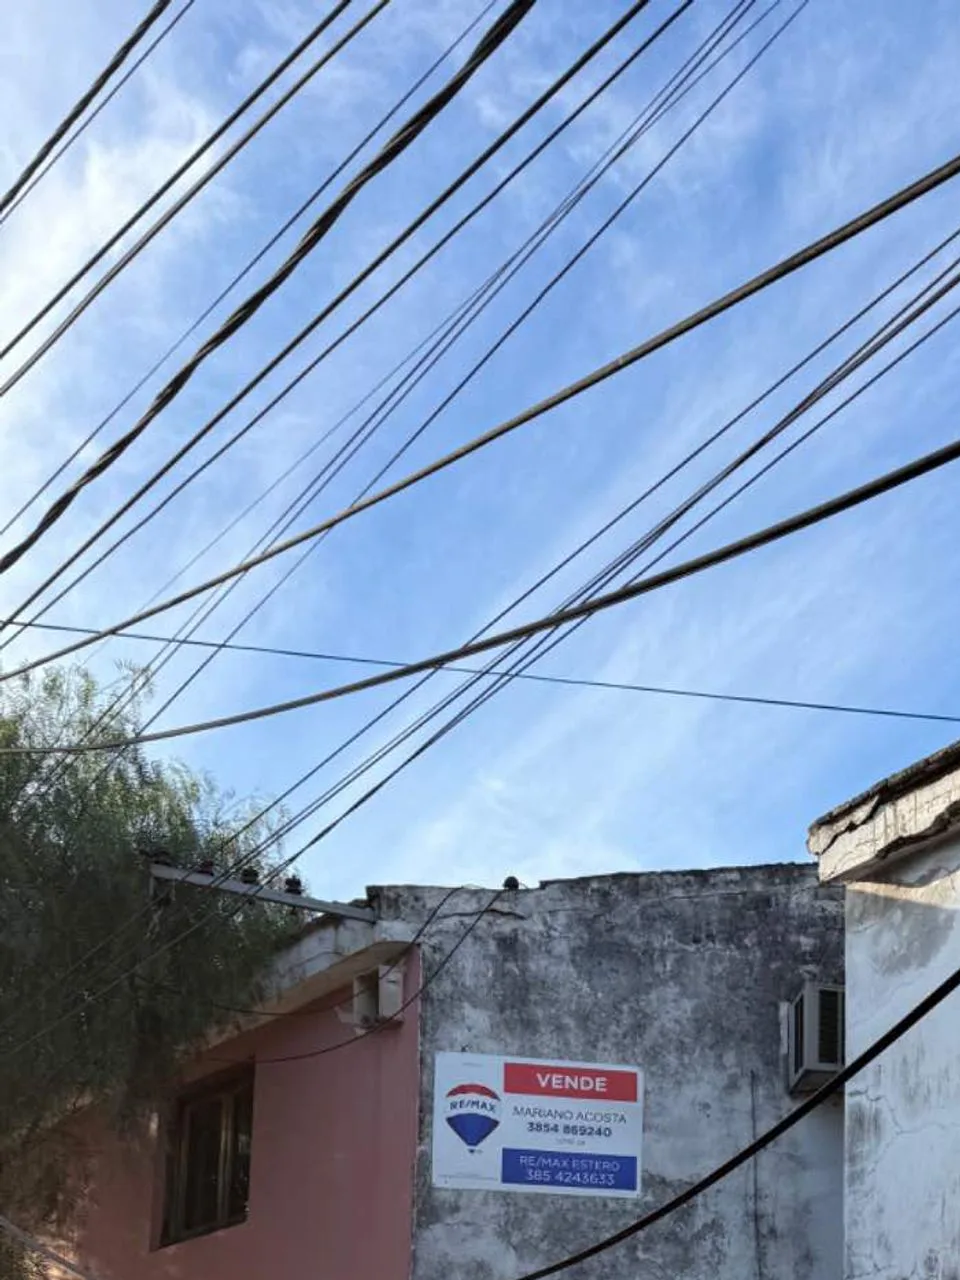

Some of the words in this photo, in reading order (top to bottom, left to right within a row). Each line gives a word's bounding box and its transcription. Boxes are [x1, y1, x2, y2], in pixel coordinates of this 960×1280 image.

[536, 1072, 608, 1092] VENDE
[450, 1100, 497, 1114] RE/MAX
[511, 1106, 574, 1121] MARIANO
[576, 1110, 627, 1125] ACOSTA
[527, 1121, 559, 1134] 3854
[519, 1155, 570, 1170] RE/MAX
[572, 1158, 620, 1172] ESTERO
[526, 1169, 551, 1182] 385
